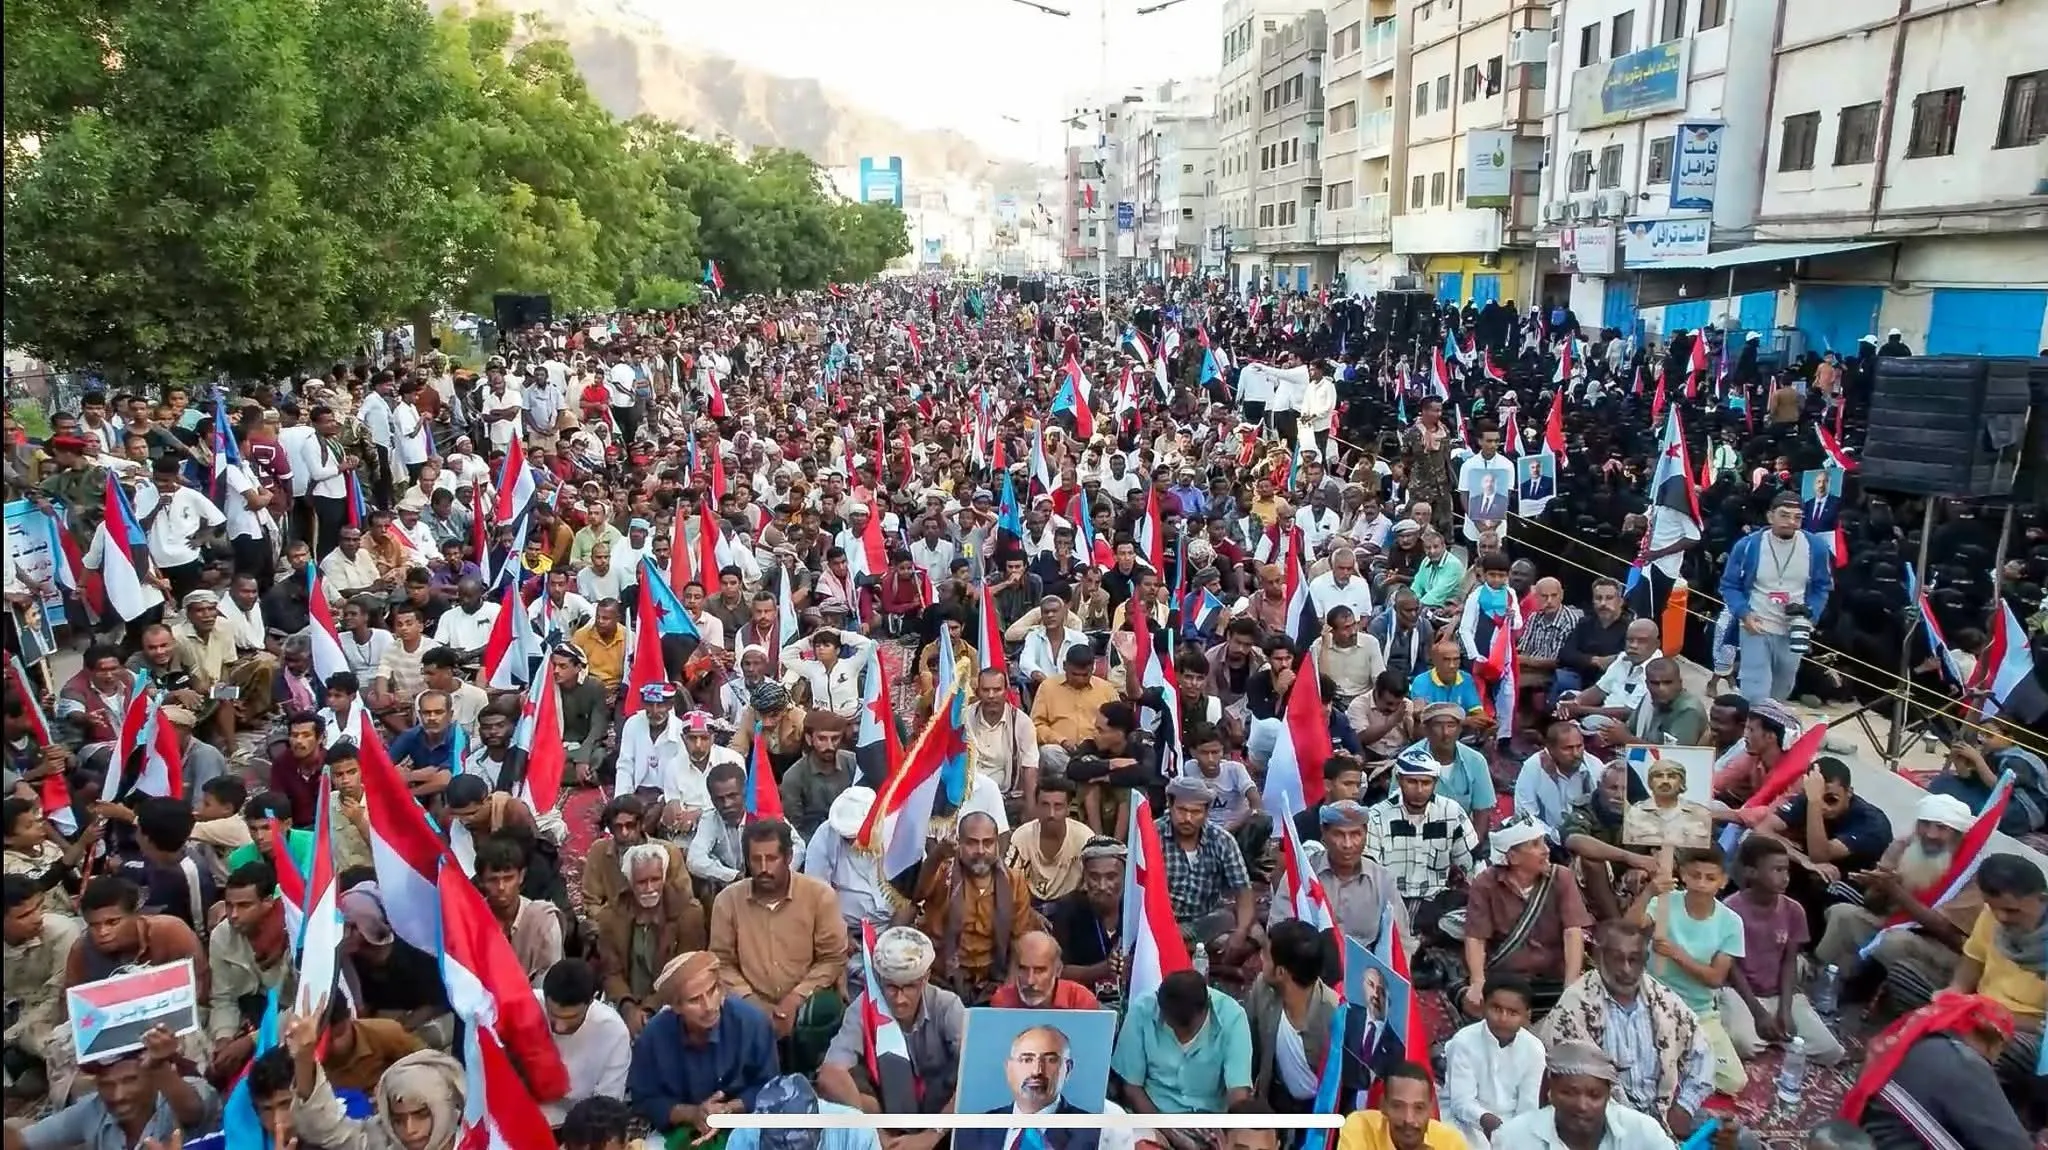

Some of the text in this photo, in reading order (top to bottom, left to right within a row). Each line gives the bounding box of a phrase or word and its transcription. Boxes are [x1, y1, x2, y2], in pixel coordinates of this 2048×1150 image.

[1684, 141, 1718, 154] فاست
[1681, 160, 1716, 176] ترافل
[1652, 223, 1706, 248] فاست ترافل
